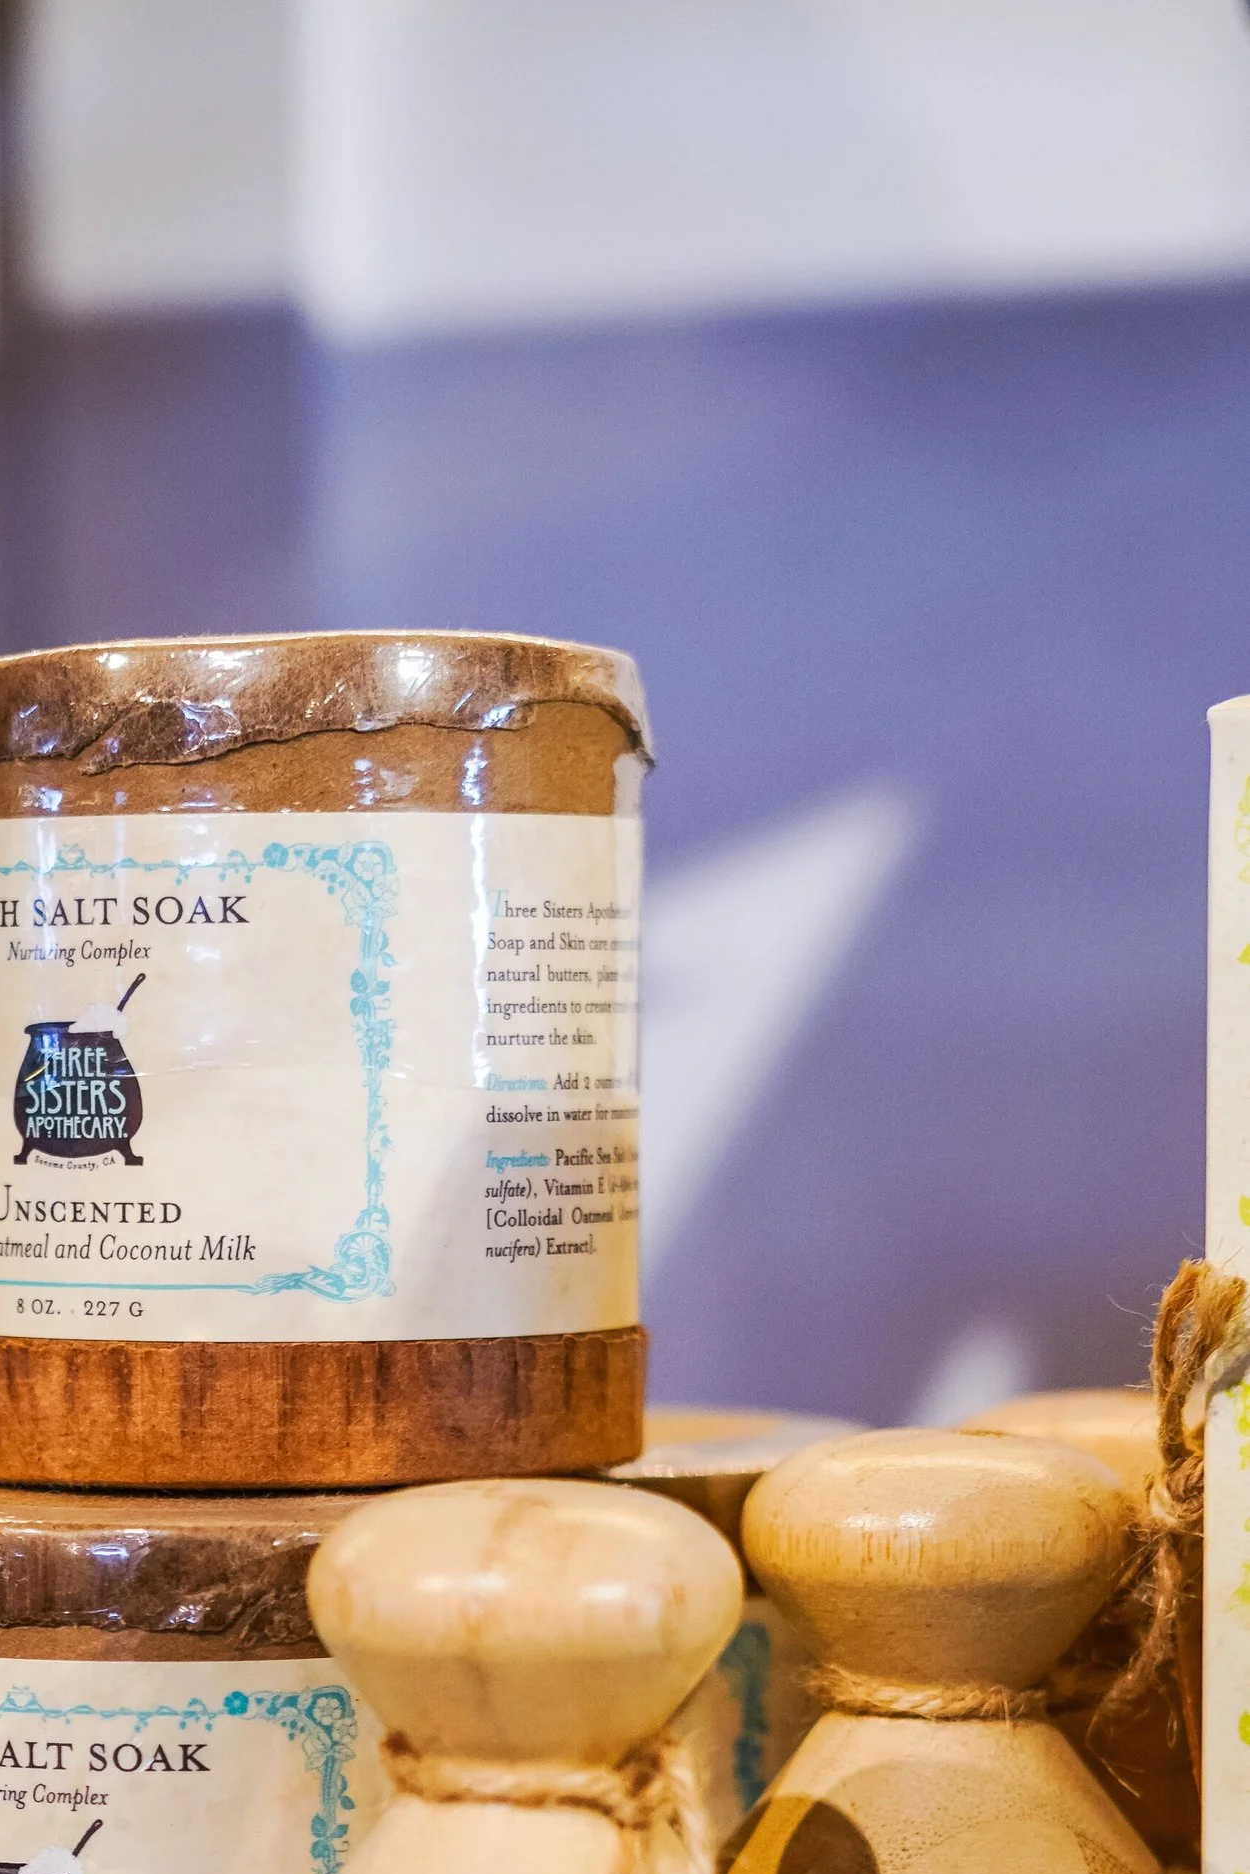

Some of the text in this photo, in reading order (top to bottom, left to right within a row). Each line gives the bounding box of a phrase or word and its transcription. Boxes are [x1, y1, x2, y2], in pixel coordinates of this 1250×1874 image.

[31, 897, 118, 927] SALT
[132, 894, 250, 926] SOAK
[543, 901, 583, 918] Sisters
[80, 939, 152, 966] Complex
[487, 932, 524, 956] Soap
[530, 933, 555, 950] and
[559, 932, 585, 950] Skin
[487, 965, 540, 982] natural
[487, 997, 567, 1020] ingredients
[571, 1000, 581, 1014] to
[486, 1033, 545, 1046] nurture
[549, 1028, 568, 1045] the
[40, 1047, 107, 1077] THREE
[553, 1073, 579, 1089] Add
[25, 1080, 126, 1115] SISTERS
[486, 1105, 542, 1122] dissolve
[547, 1107, 560, 1122] in
[555, 1148, 593, 1167] Pacific
[485, 1178, 537, 1204] sulfate),
[544, 1177, 593, 1196] Vitamin
[55, 1233, 91, 1261] and
[98, 1234, 192, 1263] Coconut
[198, 1234, 257, 1263] Milk
[485, 1237, 541, 1263] nucifera)
[16, 1299, 145, 1318] 8 OZ. 227 G
[89, 1743, 210, 1772] SOAK
[32, 1784, 109, 1811] Complex
